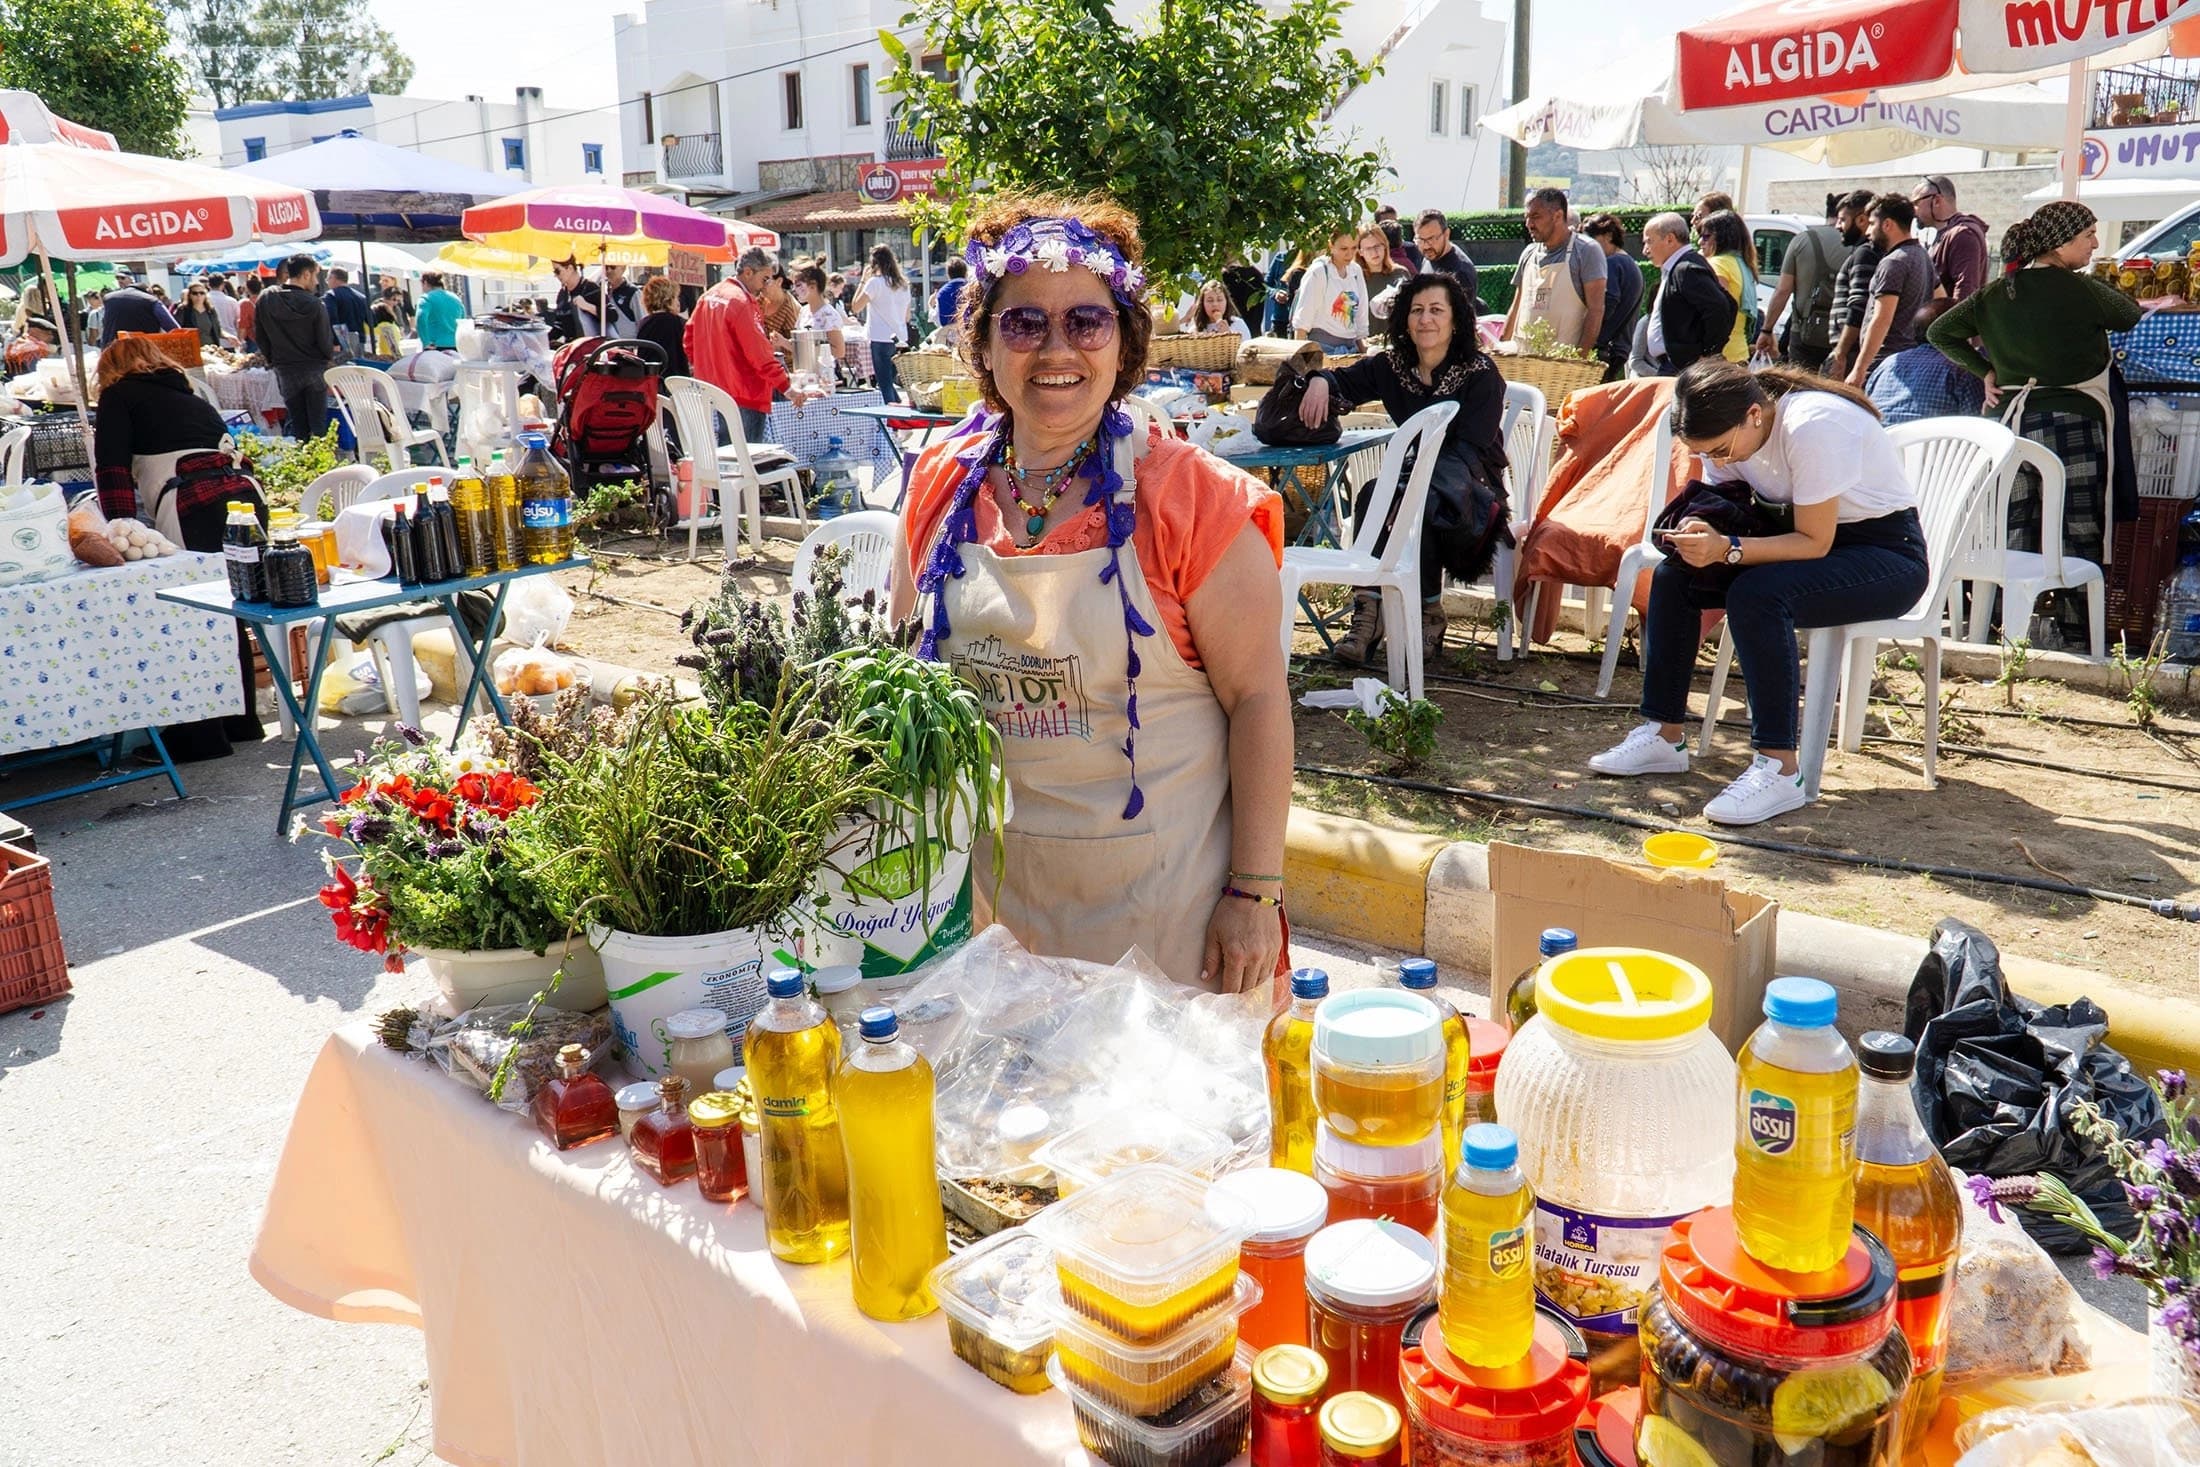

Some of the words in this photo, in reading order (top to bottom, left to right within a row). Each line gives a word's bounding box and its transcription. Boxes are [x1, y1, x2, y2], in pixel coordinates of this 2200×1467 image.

[554, 216, 613, 233] ALGIDA
[523, 502, 554, 520] eysu
[1020, 654, 1052, 670] BODRUM
[1020, 676, 1064, 704] OT
[983, 701, 1070, 740] ESTİVALİ
[836, 907, 899, 938] Doğal
[763, 1096, 806, 1108] damla
[1752, 1111, 1791, 1140] assu
[1493, 1244, 1524, 1266] assu
[1564, 1240, 1596, 1253] HORECA
[1535, 1243, 1580, 1271] alatalık
[1584, 1257, 1641, 1278] Turşusu
